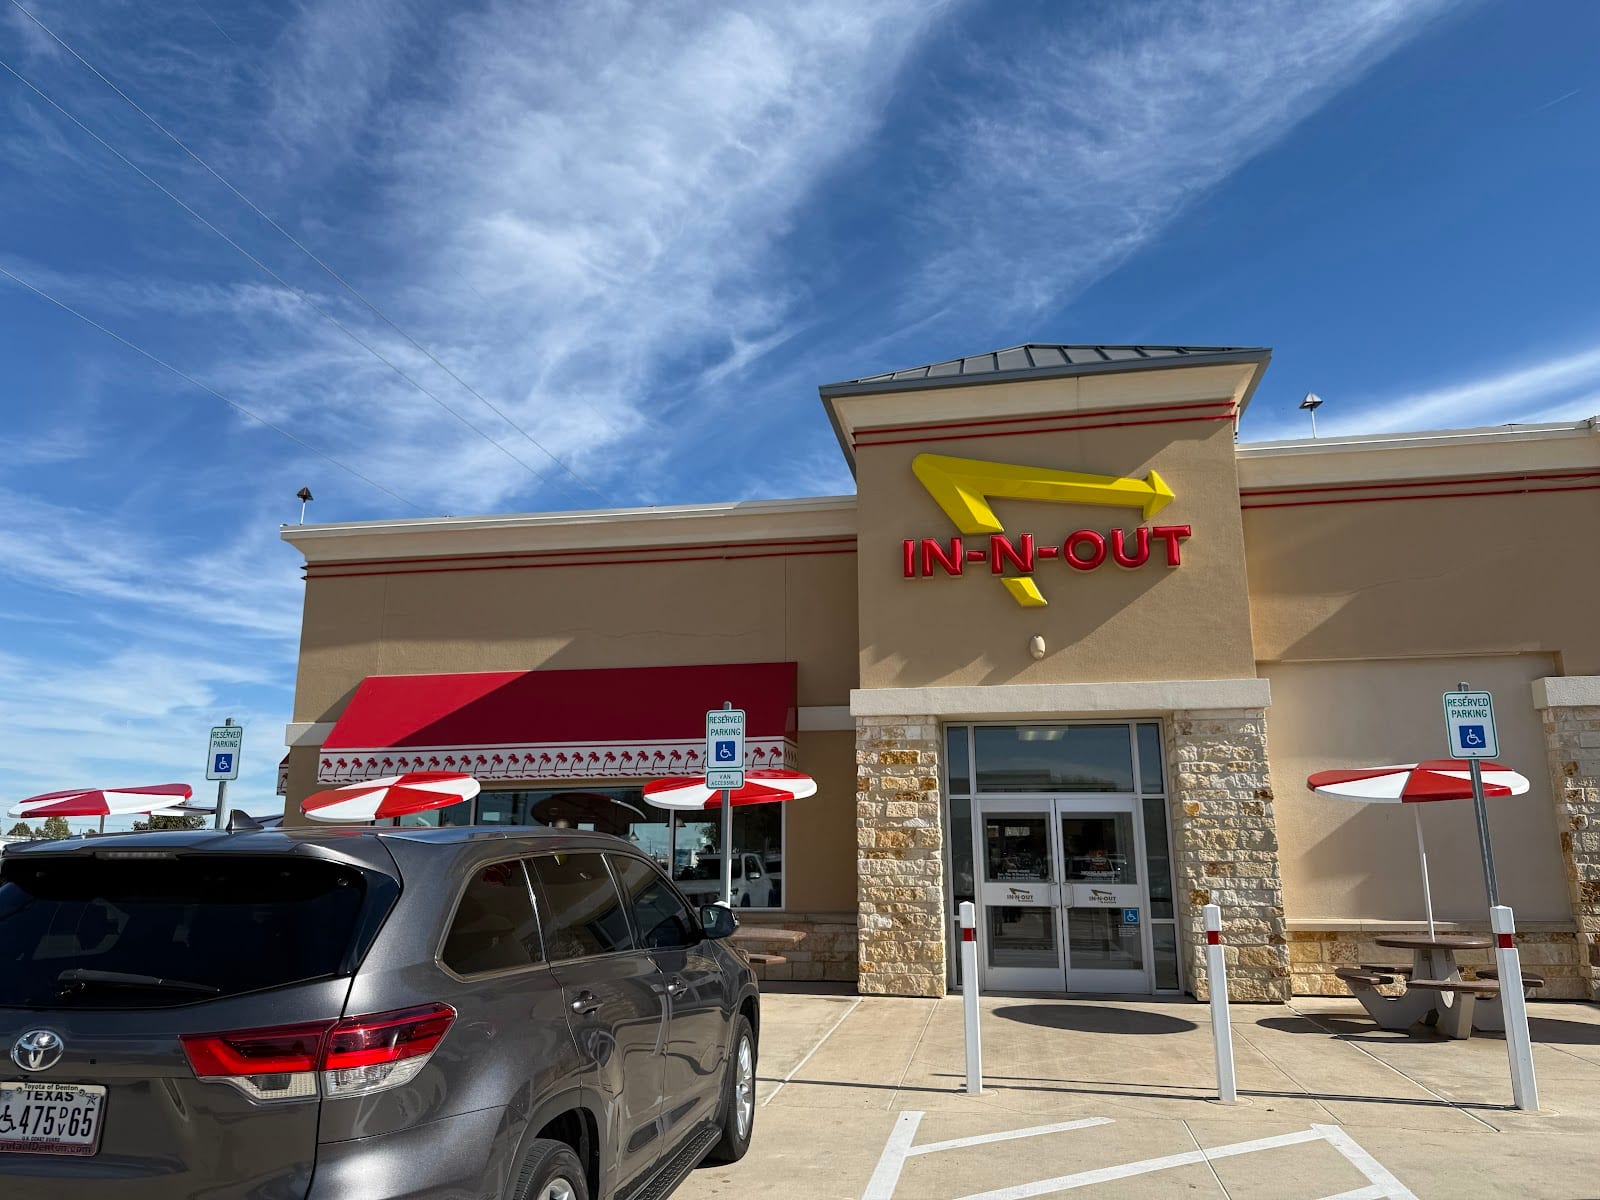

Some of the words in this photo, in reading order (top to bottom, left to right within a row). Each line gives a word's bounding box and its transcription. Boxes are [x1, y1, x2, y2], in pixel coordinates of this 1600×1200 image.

[903, 525, 1191, 578] IN-N-OUT
[1447, 698, 1489, 707] RESERVED
[1451, 709, 1488, 718] PARKING
[709, 715, 743, 724] RESERVED
[212, 730, 241, 739] RESERVED
[710, 728, 741, 736] PARKING
[213, 740, 238, 748] PARKING
[26, 1091, 75, 1102] TEXAS
